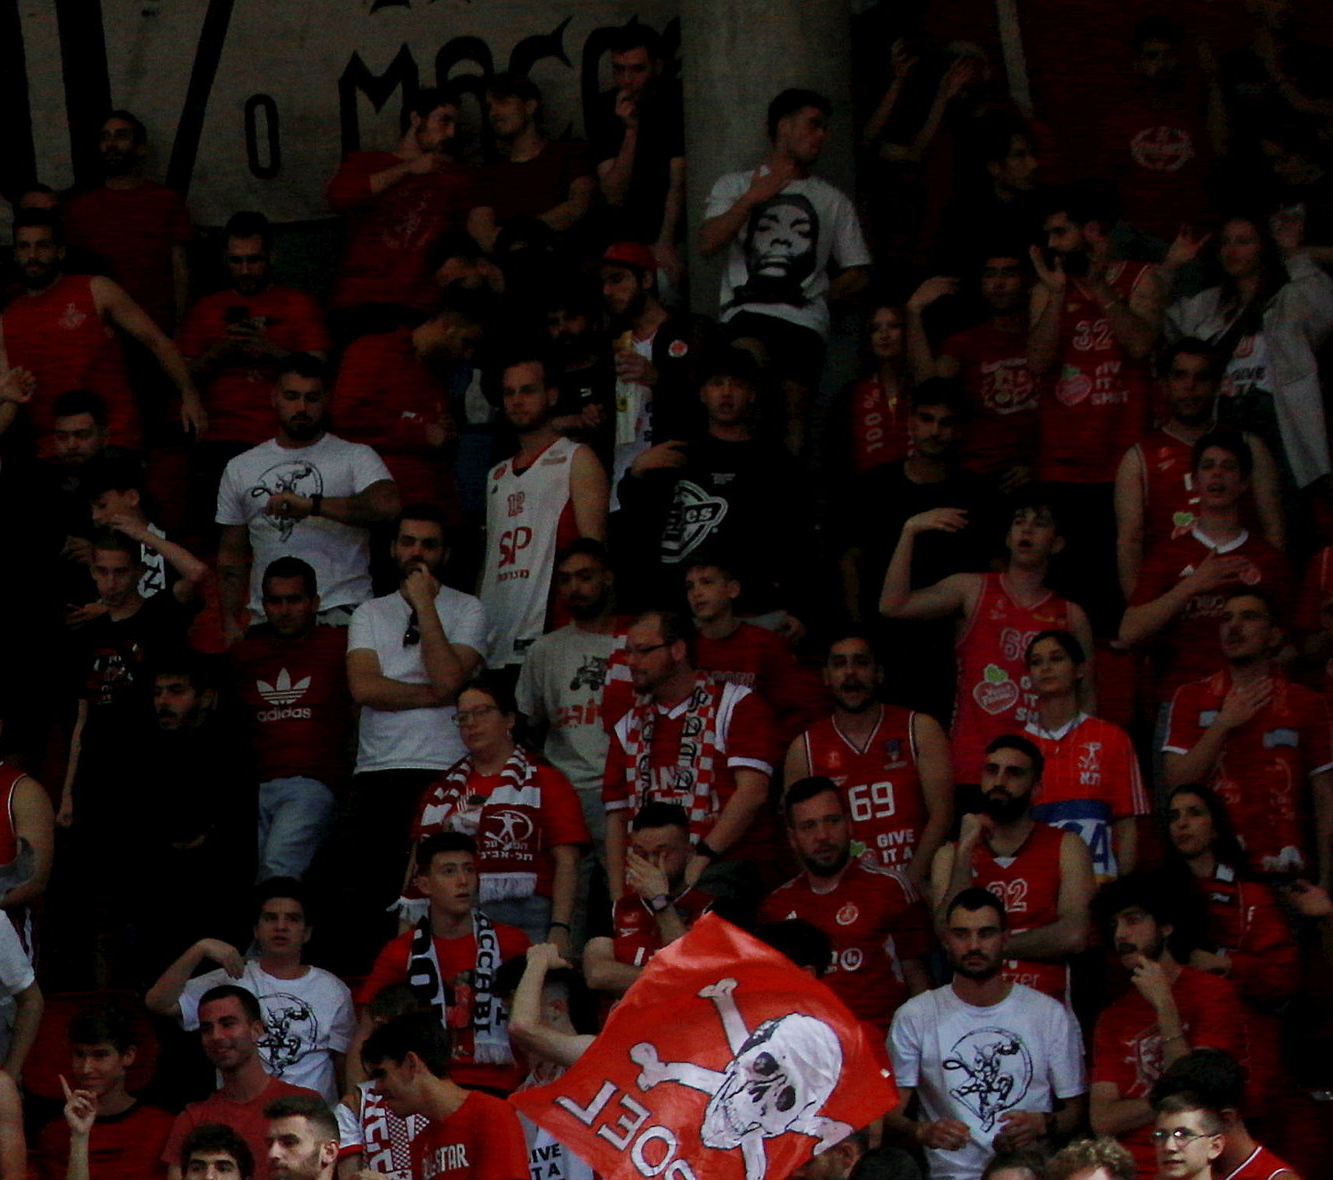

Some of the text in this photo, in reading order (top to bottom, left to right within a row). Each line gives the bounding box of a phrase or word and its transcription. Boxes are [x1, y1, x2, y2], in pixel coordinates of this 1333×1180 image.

[256, 707, 313, 722] adidas
[848, 781, 895, 822] 69
[876, 828, 916, 848] GIVE
[530, 1142, 560, 1164] IVE
